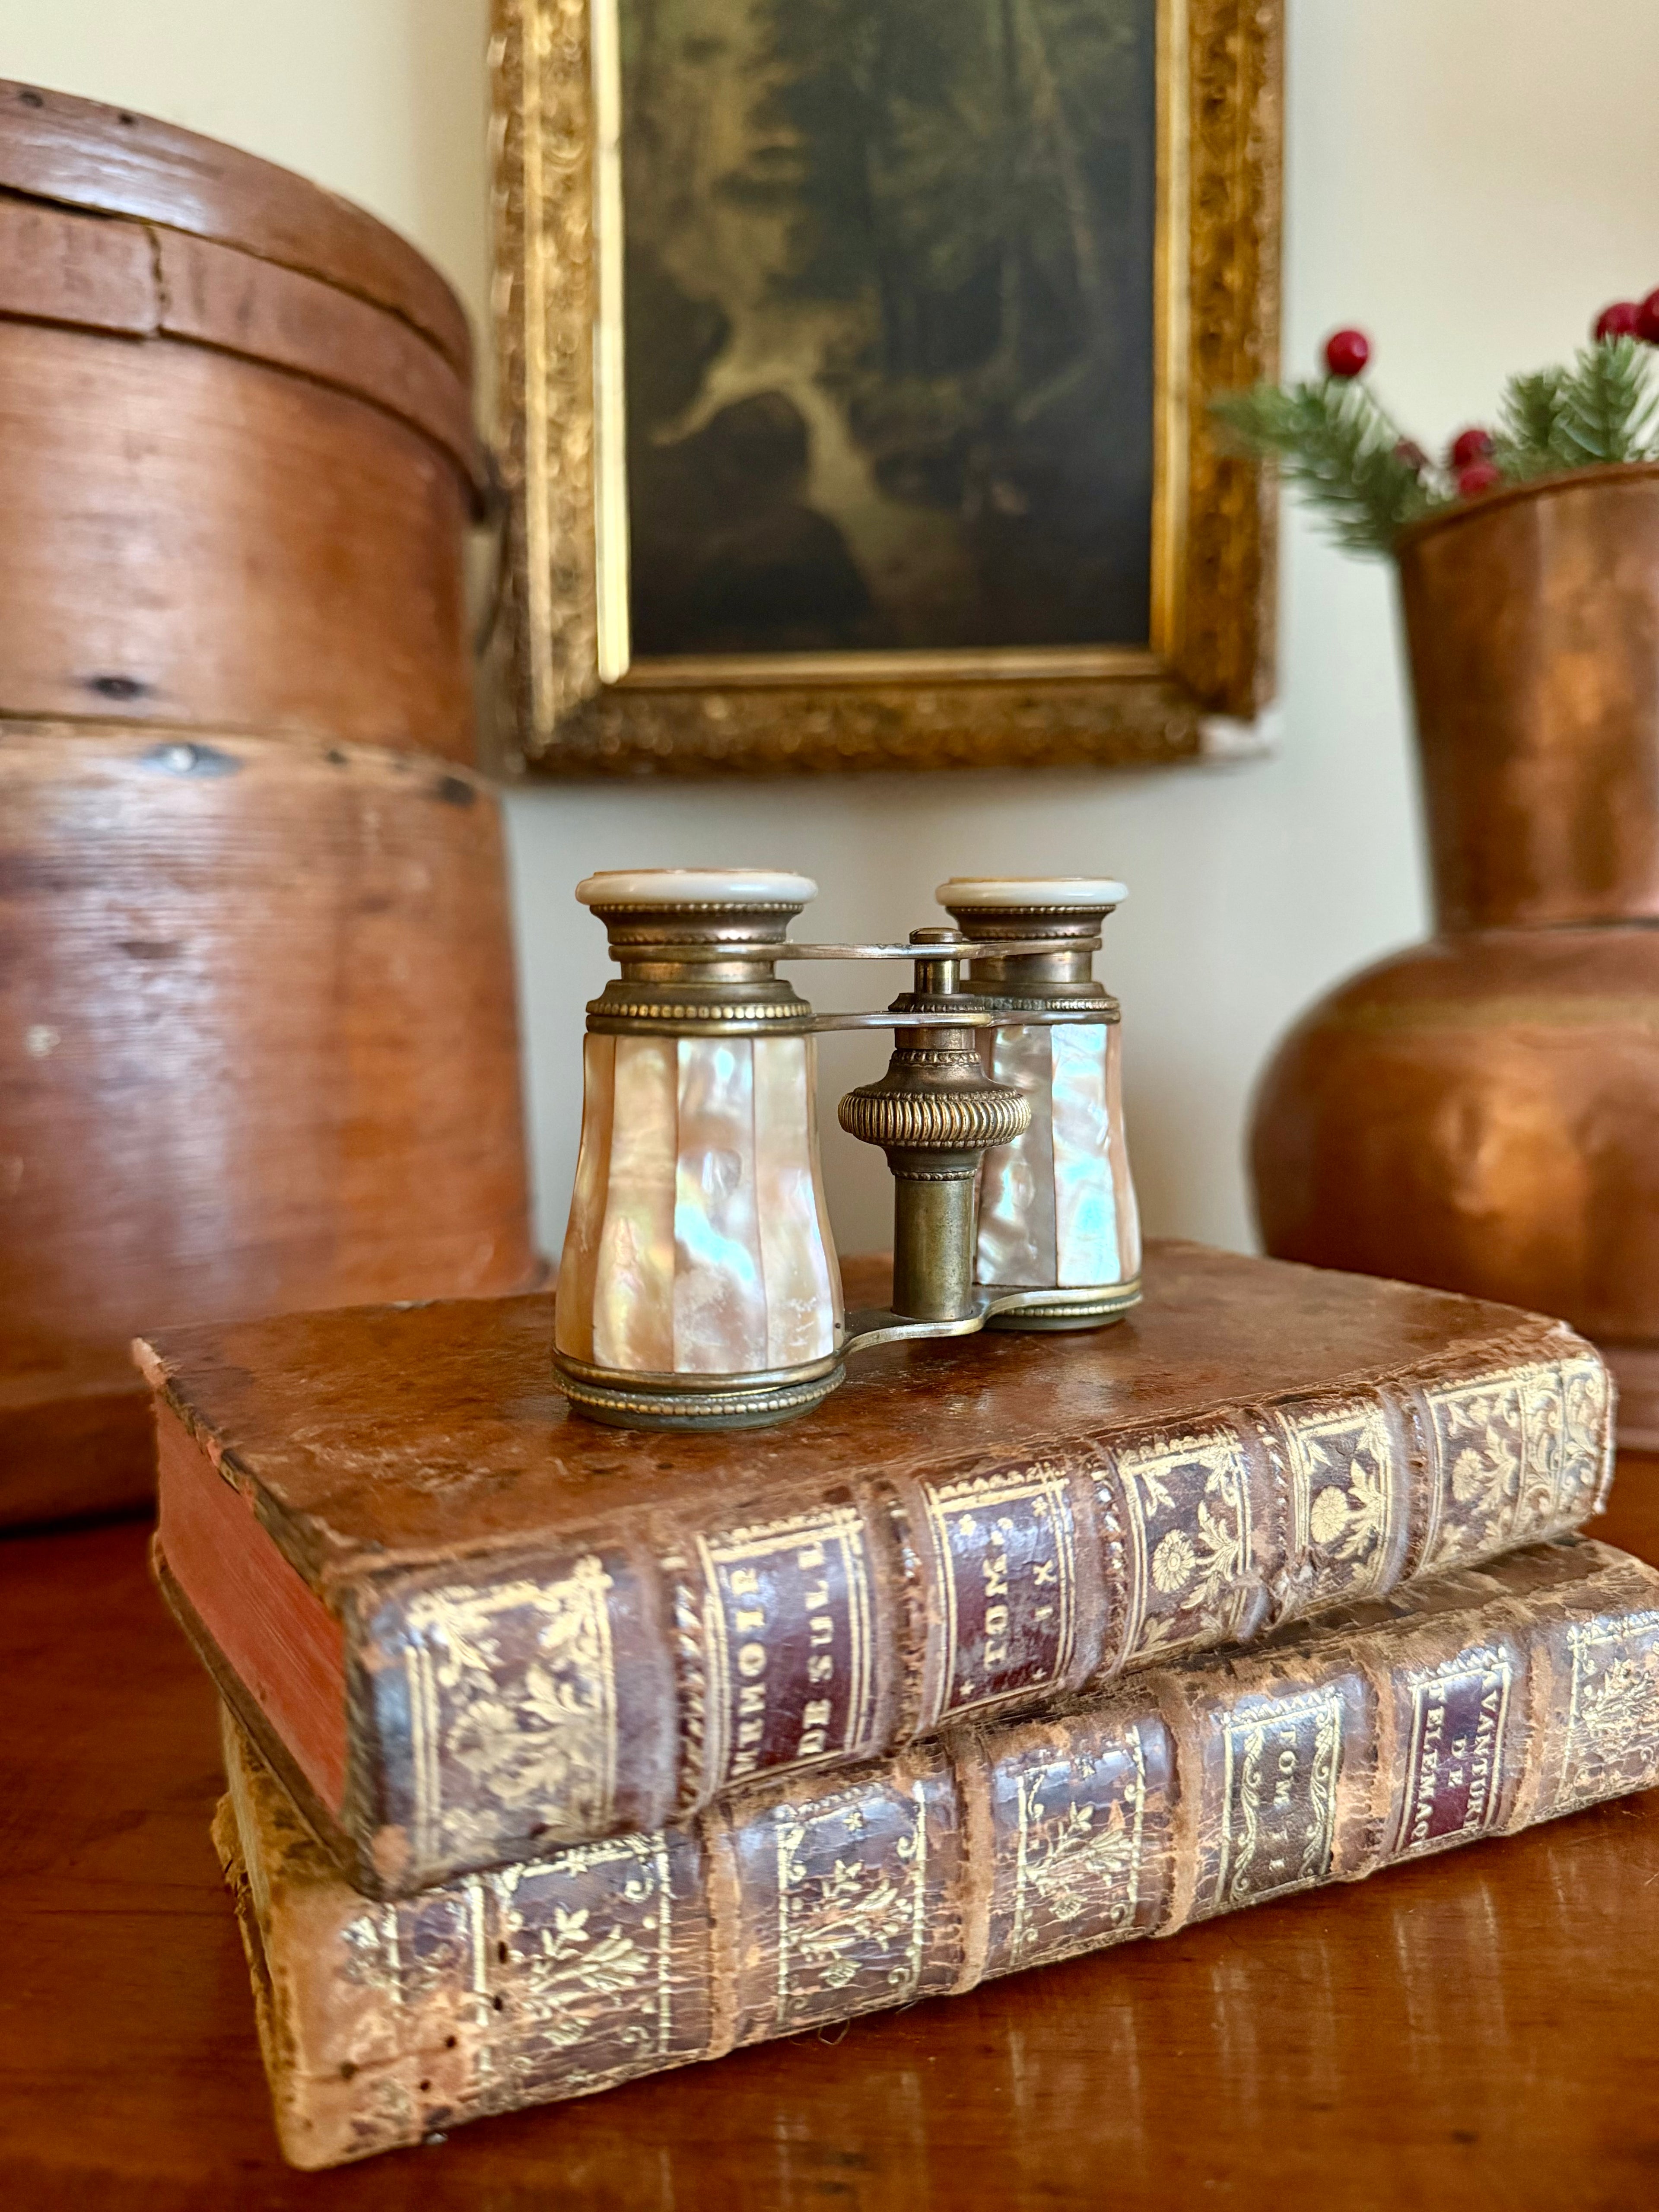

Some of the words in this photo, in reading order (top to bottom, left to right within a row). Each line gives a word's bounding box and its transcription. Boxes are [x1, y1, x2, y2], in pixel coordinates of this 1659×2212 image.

[798, 1699, 833, 1756] DE
[1273, 1725, 1296, 1808] TOM
[1448, 1736, 1467, 1788] DE
